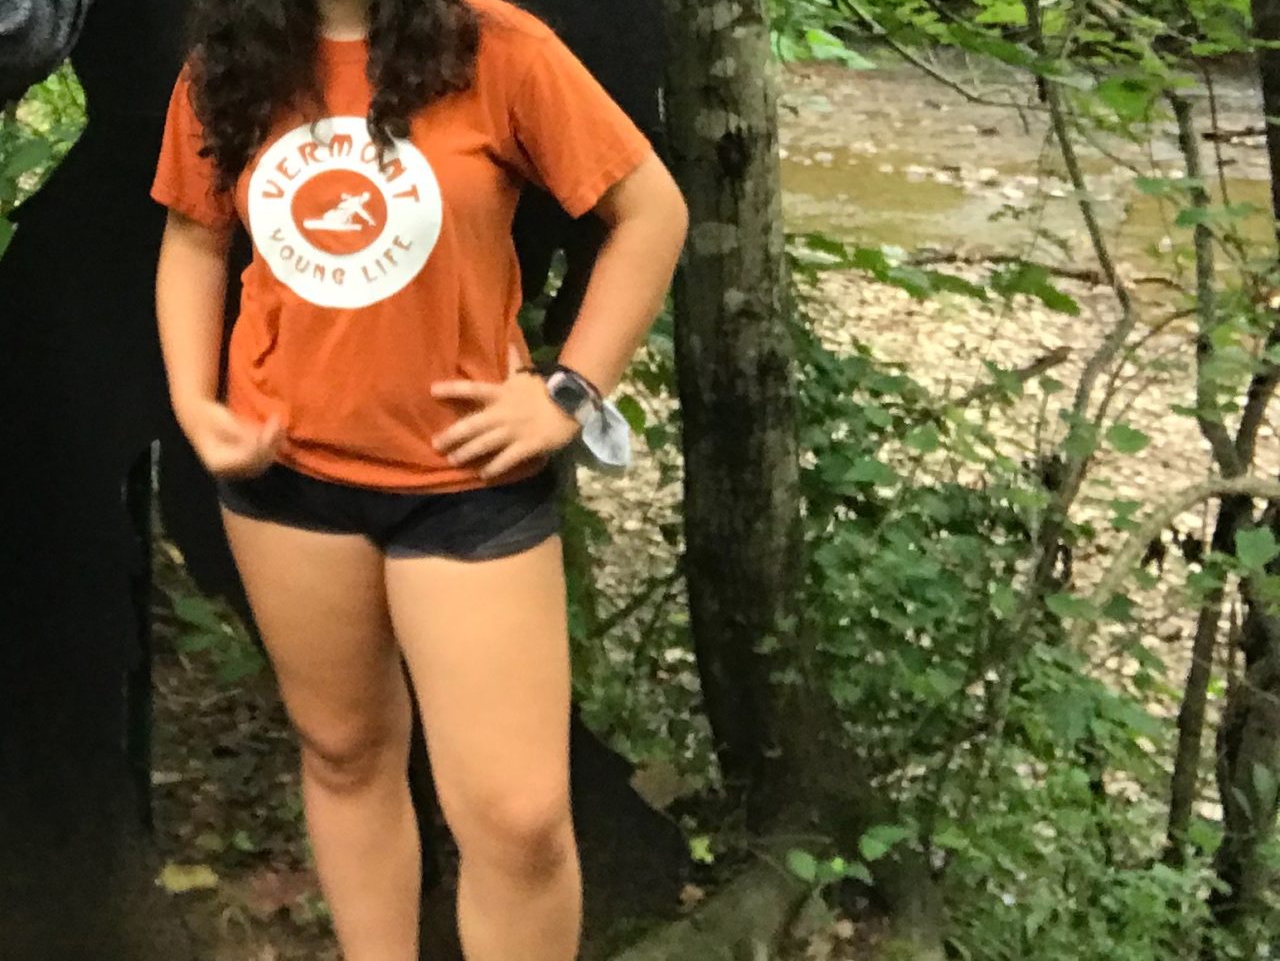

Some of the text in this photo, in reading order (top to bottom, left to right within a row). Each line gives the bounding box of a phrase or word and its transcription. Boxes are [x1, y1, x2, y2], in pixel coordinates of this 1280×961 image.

[262, 133, 420, 203] VERMONT
[270, 228, 413, 285] YOUNG LIFE
